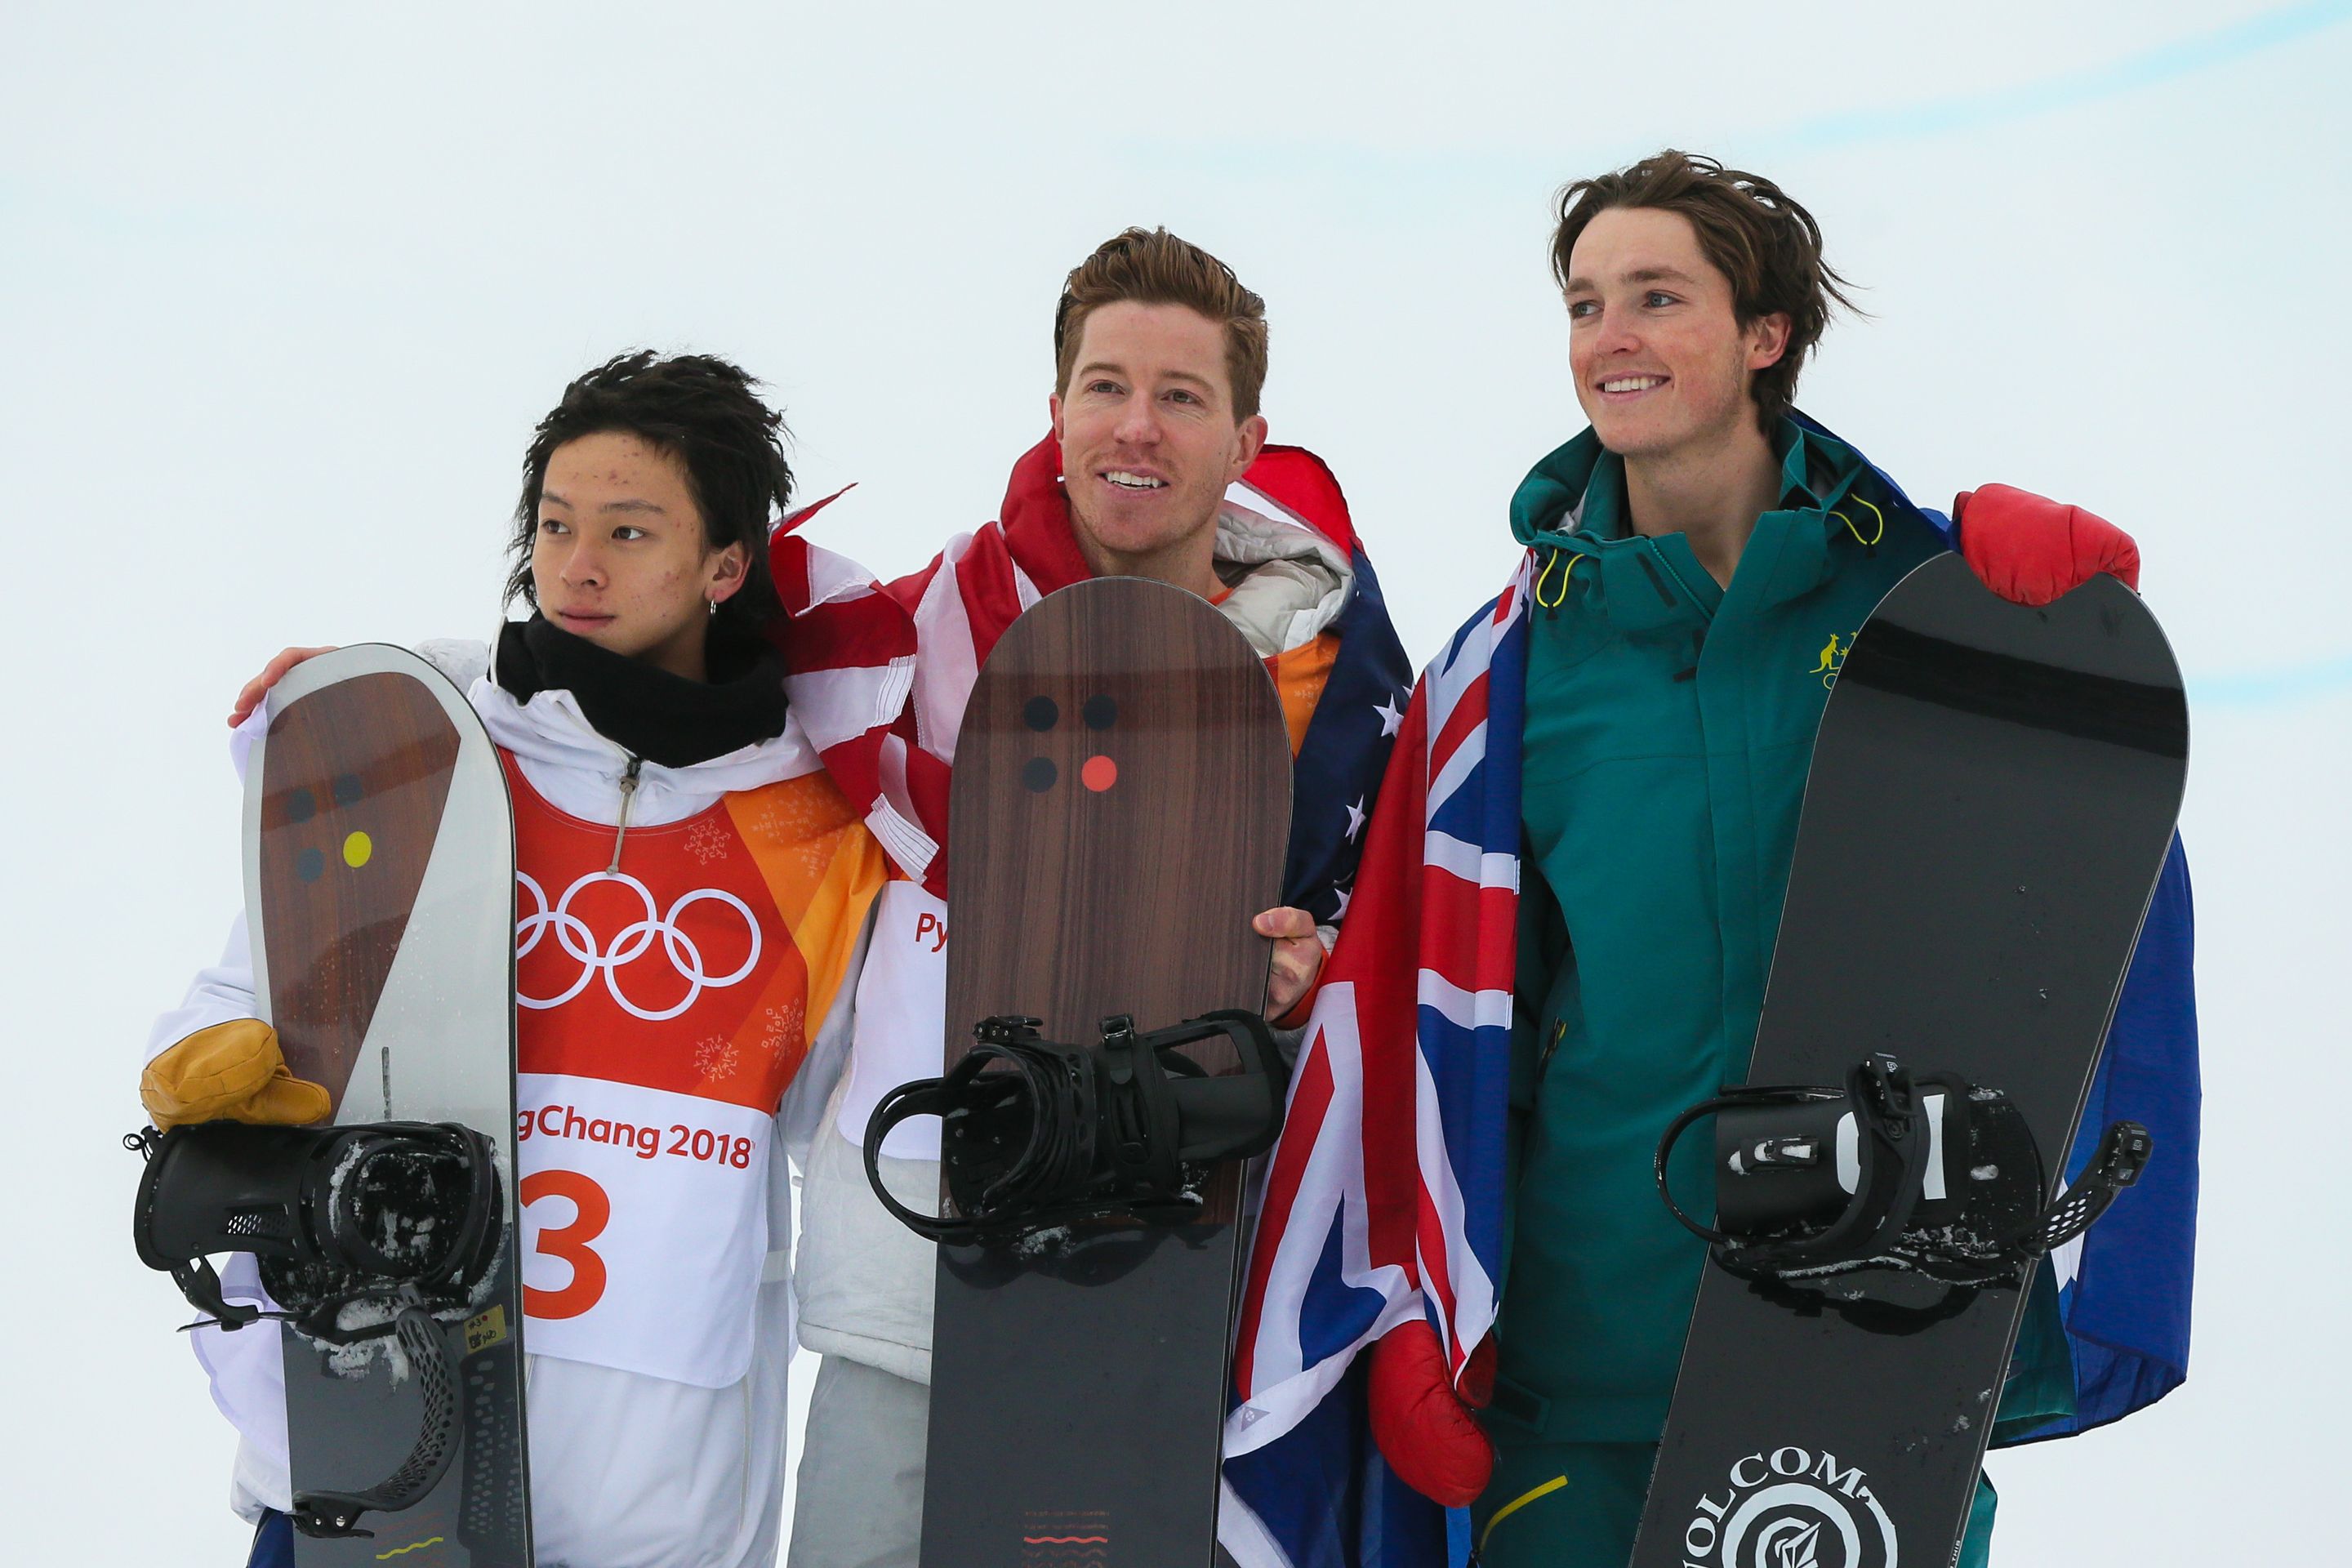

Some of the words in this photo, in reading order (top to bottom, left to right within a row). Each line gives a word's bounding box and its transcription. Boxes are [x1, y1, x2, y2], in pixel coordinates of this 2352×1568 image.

[915, 912, 948, 953] Py
[519, 1104, 660, 1160] gChang
[666, 1124, 751, 1169] 2018
[519, 1169, 611, 1320] 3
[1682, 1446, 1867, 1568] OLCOM
